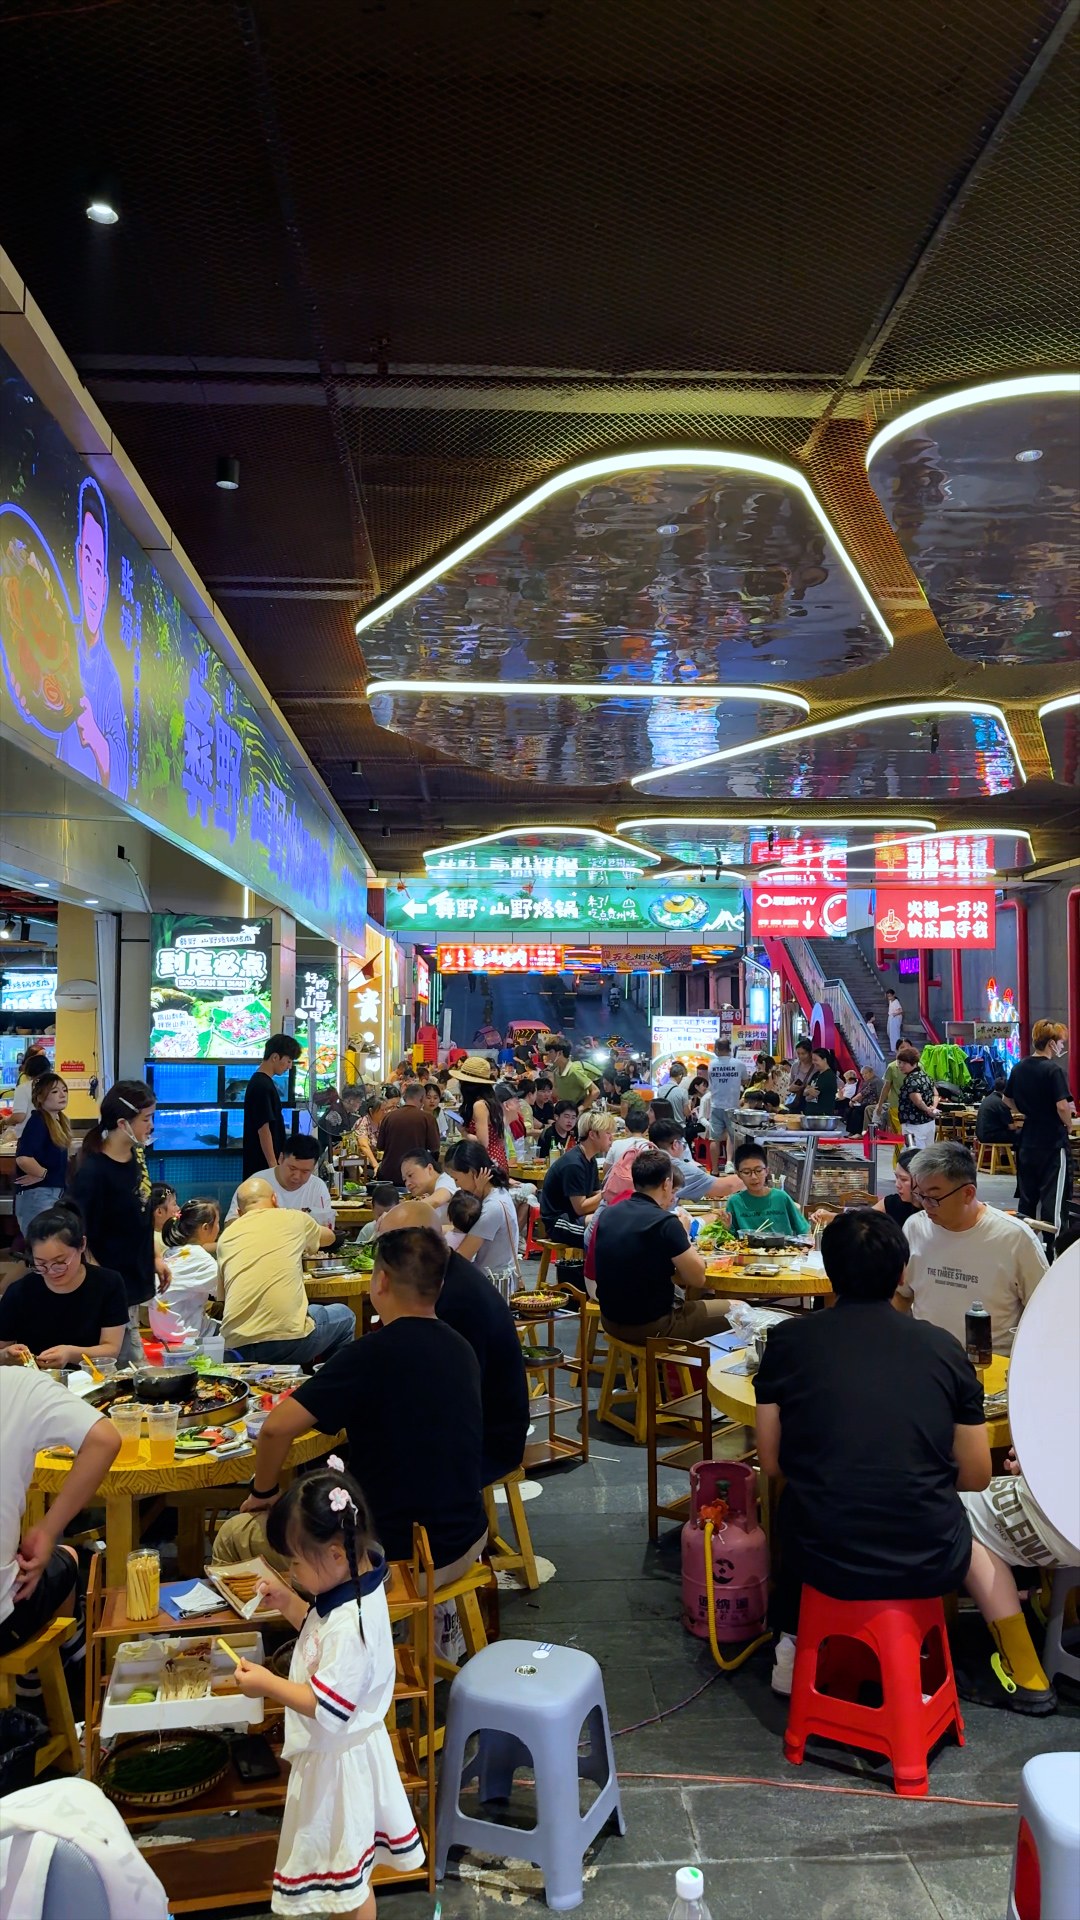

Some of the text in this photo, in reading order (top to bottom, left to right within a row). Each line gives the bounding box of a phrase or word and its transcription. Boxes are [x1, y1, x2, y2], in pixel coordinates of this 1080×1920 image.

[588, 907, 640, 921] 吃点贵州味
[907, 900, 988, 918] 火锅一开火
[907, 920, 988, 938] 快乐属于我
[159, 950, 265, 977] 到店必点
[178, 979, 196, 987] DAO
[226, 979, 246, 987] DIAN
[927, 1267, 937, 1276] THE
[937, 1269, 955, 1279] THREE
[955, 1272, 979, 1284] STRIPES
